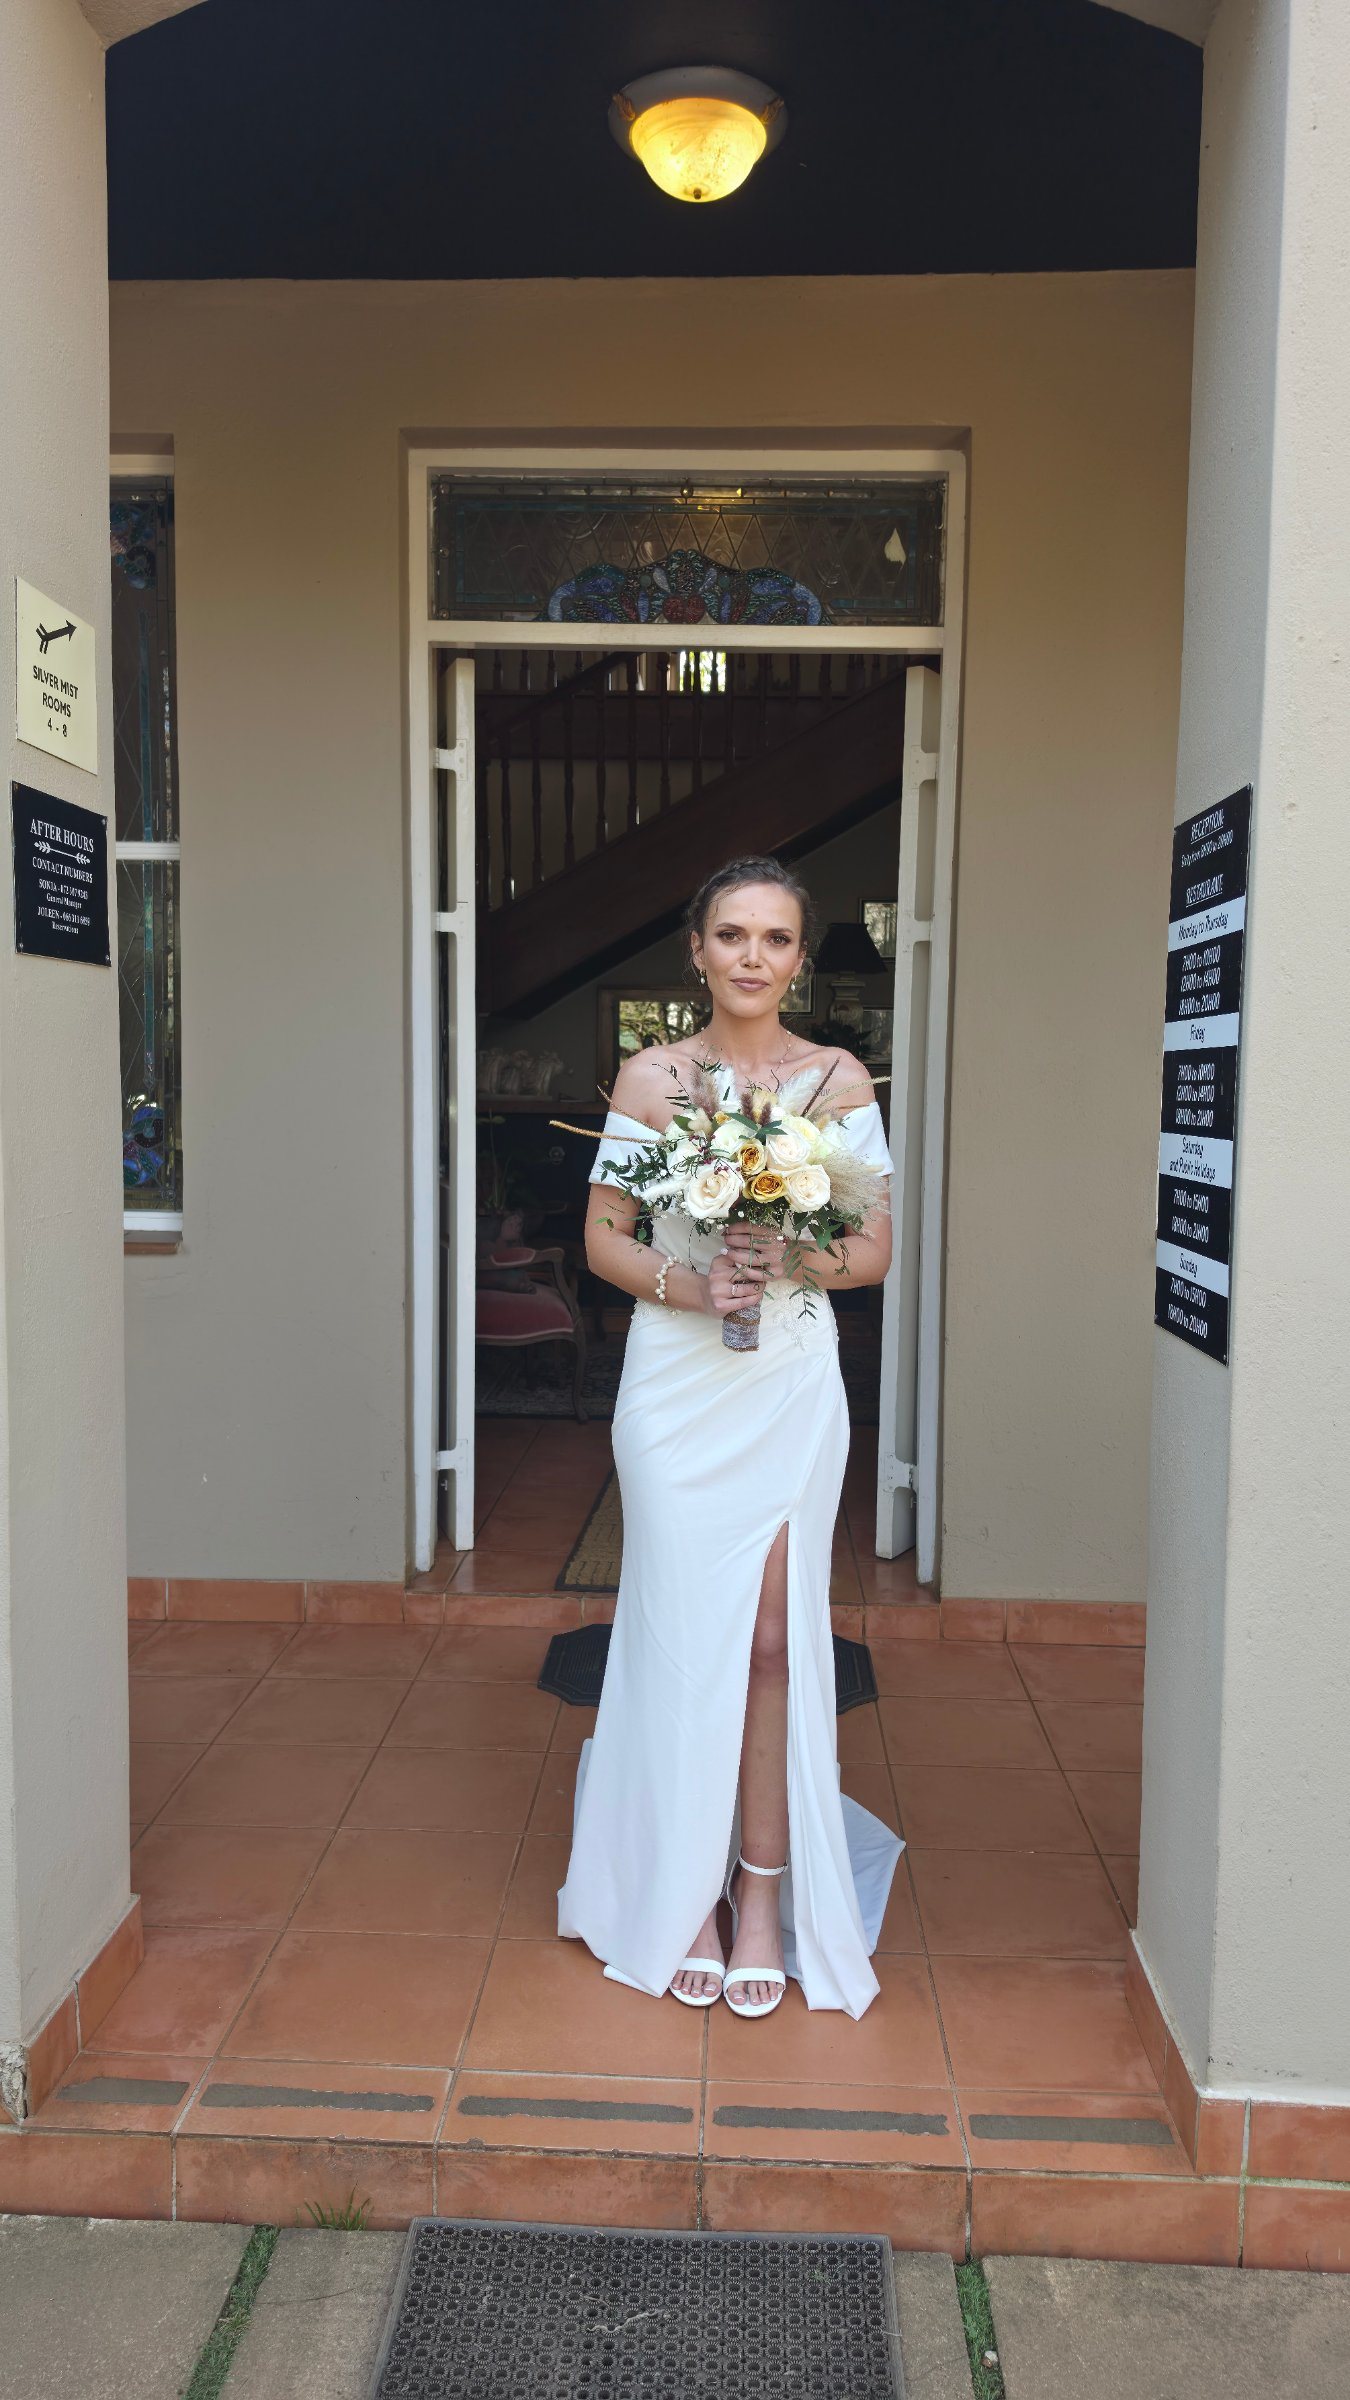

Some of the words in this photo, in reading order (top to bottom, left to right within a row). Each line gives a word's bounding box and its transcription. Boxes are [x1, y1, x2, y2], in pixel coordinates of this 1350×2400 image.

[33, 665, 59, 691] SILVER
[60, 678, 78, 700] MIST
[42, 692, 71, 718] ROOMS
[48, 718, 52, 731] 4
[63, 724, 67, 738] 8
[30, 818, 62, 843] AFTER
[64, 829, 94, 853] HOURS
[33, 857, 63, 874] CONTACT
[64, 866, 92, 883] NUMBERS
[1179, 922, 1198, 940] Monday
[1199, 921, 1204, 934] to
[1205, 912, 1228, 932] Thursday
[1197, 954, 1202, 968] to
[1197, 976, 1202, 988] to
[1195, 1000, 1200, 1012] to
[1190, 1024, 1205, 1043] Friday
[1192, 1068, 1197, 1080] to
[1192, 1088, 1197, 1101] to
[1191, 1113, 1196, 1125] to
[1183, 1137, 1203, 1158] Saturday
[1170, 1159, 1178, 1172] and
[1179, 1157, 1193, 1175] Public
[1194, 1160, 1215, 1182] Holidays
[1187, 1195, 1192, 1208] to
[1187, 1223, 1192, 1237] to
[1180, 1253, 1197, 1278] Sunday
[1184, 1286, 1189, 1300] to
[1184, 1314, 1188, 1328] to
